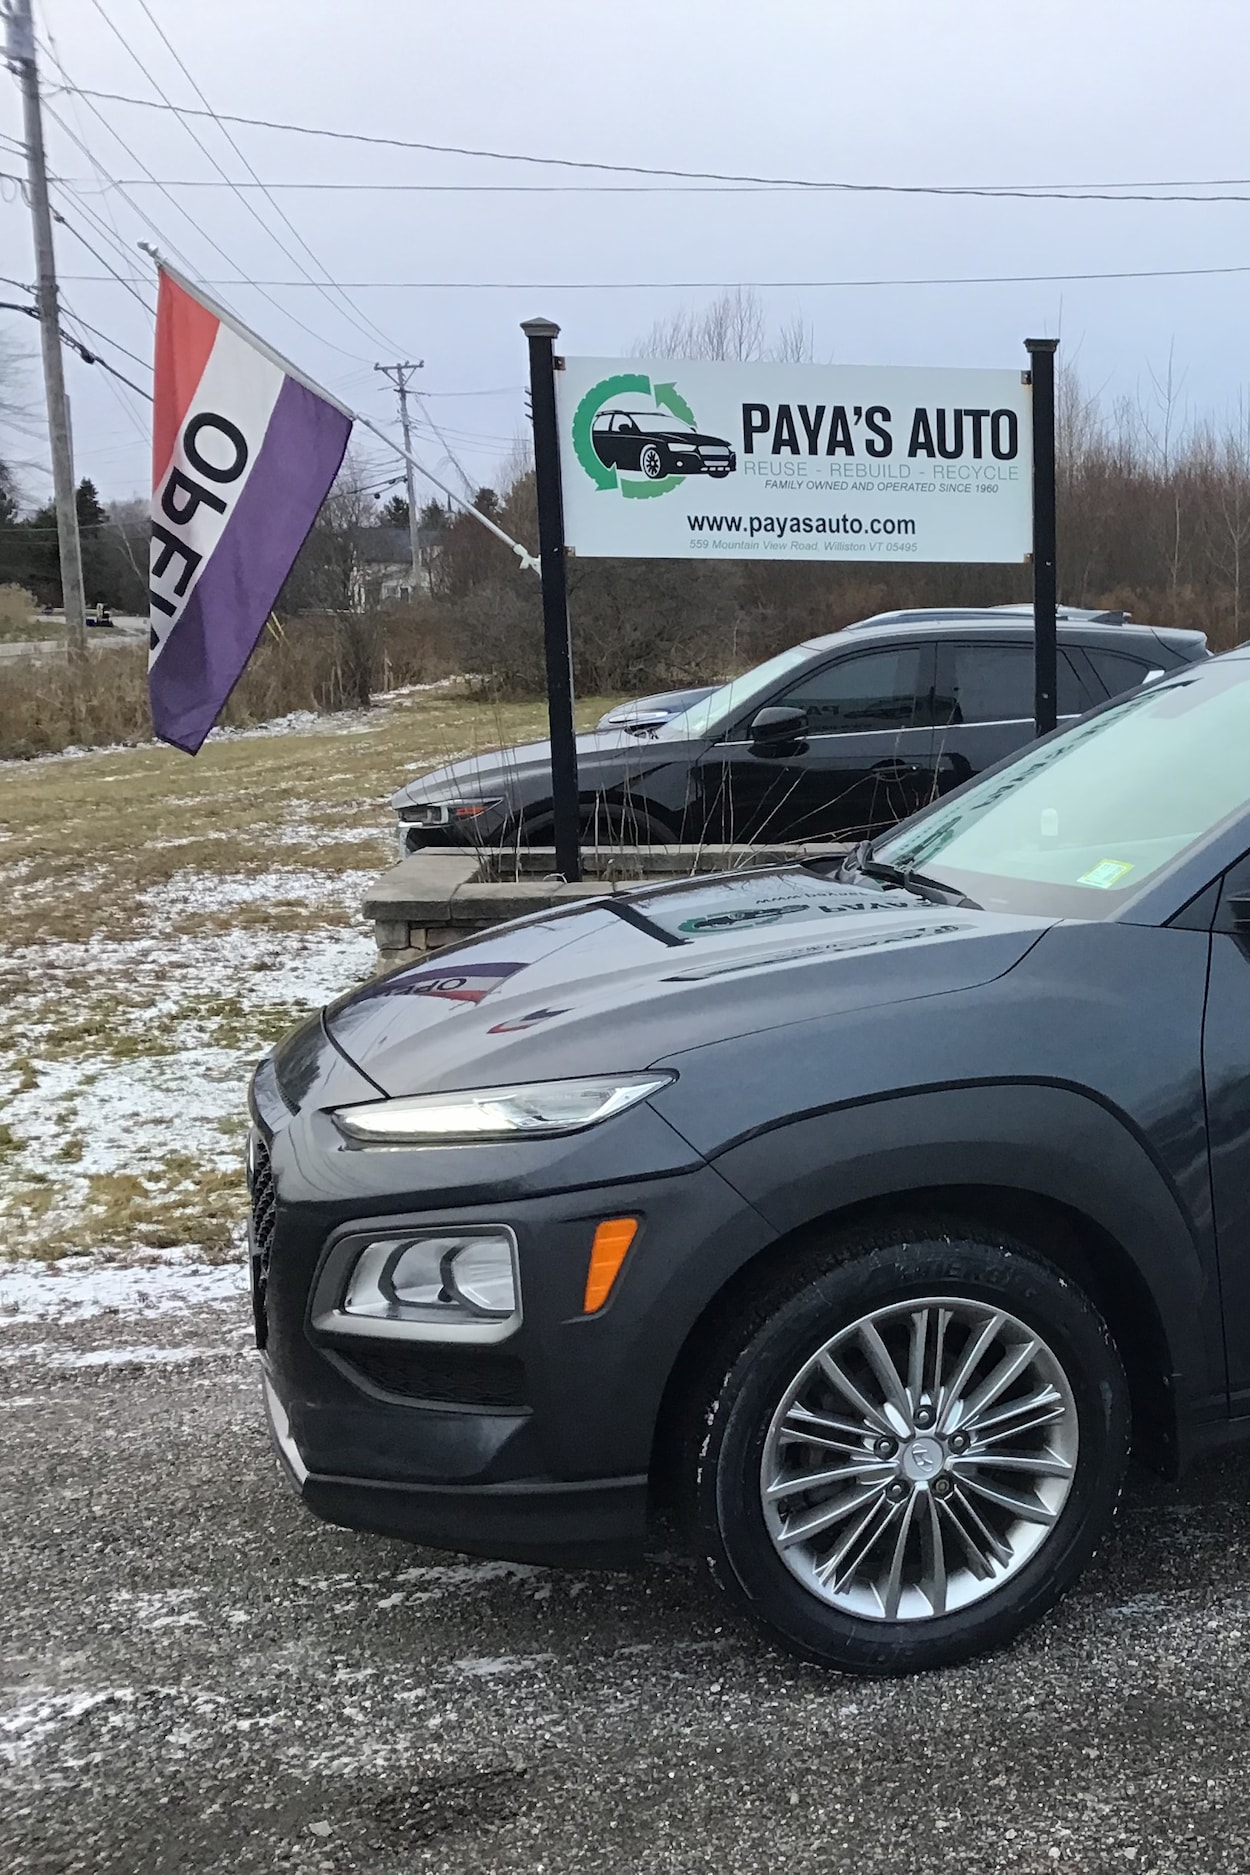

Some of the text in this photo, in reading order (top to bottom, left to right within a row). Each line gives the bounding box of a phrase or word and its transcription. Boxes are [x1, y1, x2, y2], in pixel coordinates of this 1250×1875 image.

[742, 402, 1018, 460] PAYA'S AUTO
[744, 461, 808, 477] REUSE
[830, 462, 911, 479] REBUILD
[933, 465, 1019, 481] RECYCLE
[764, 479, 999, 494] FAMILY OWNED AND OPERATED SINCE 1960
[686, 514, 917, 538] www.payasauto.com
[689, 539, 709, 549] 559
[712, 539, 760, 550] Mountain
[763, 540, 787, 551] View
[824, 541, 866, 552] Williston
[869, 542, 884, 552] VT
[886, 542, 918, 552] 05495
